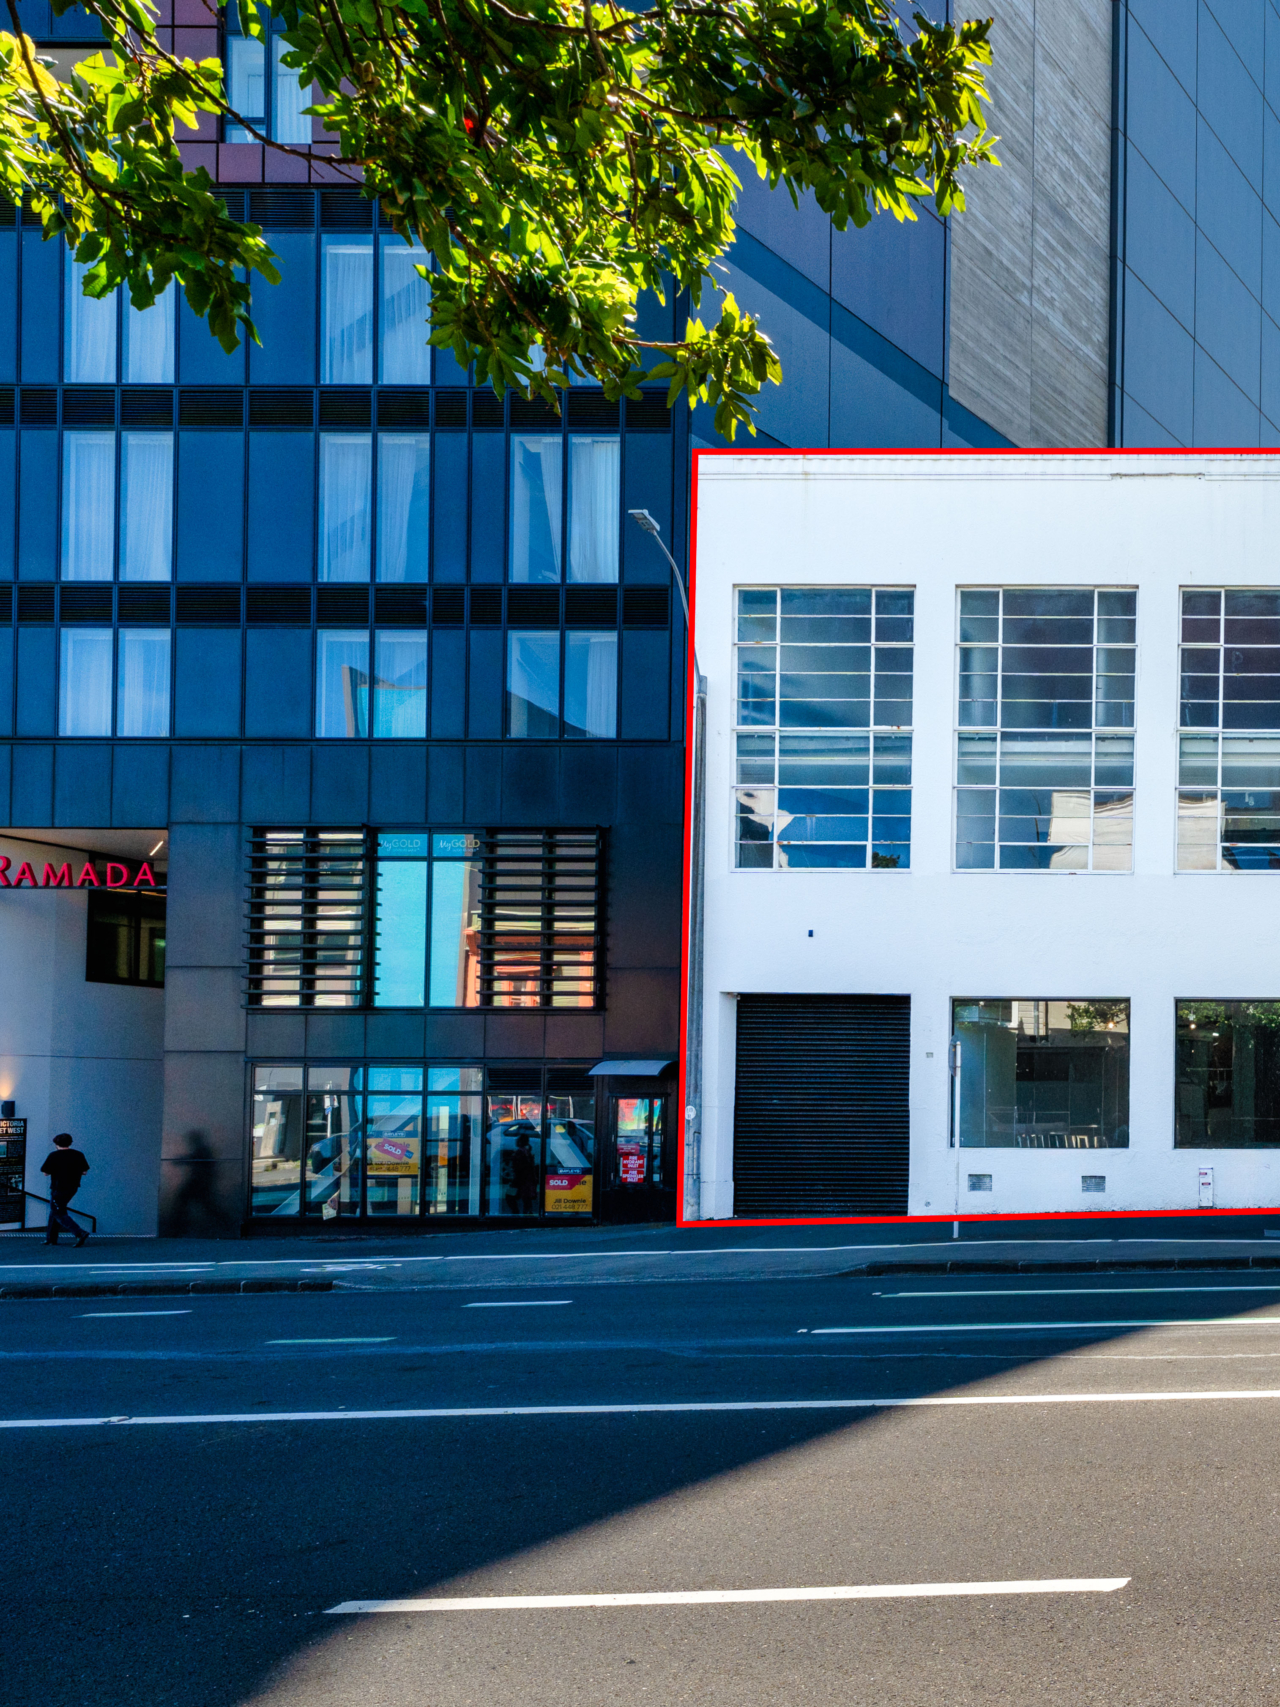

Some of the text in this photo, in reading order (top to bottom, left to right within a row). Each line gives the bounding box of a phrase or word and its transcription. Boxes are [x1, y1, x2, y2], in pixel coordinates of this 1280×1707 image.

[439, 839, 480, 851] MyGOLD
[0, 855, 156, 887] RAMADA
[384, 1143, 402, 1155] SOLD
